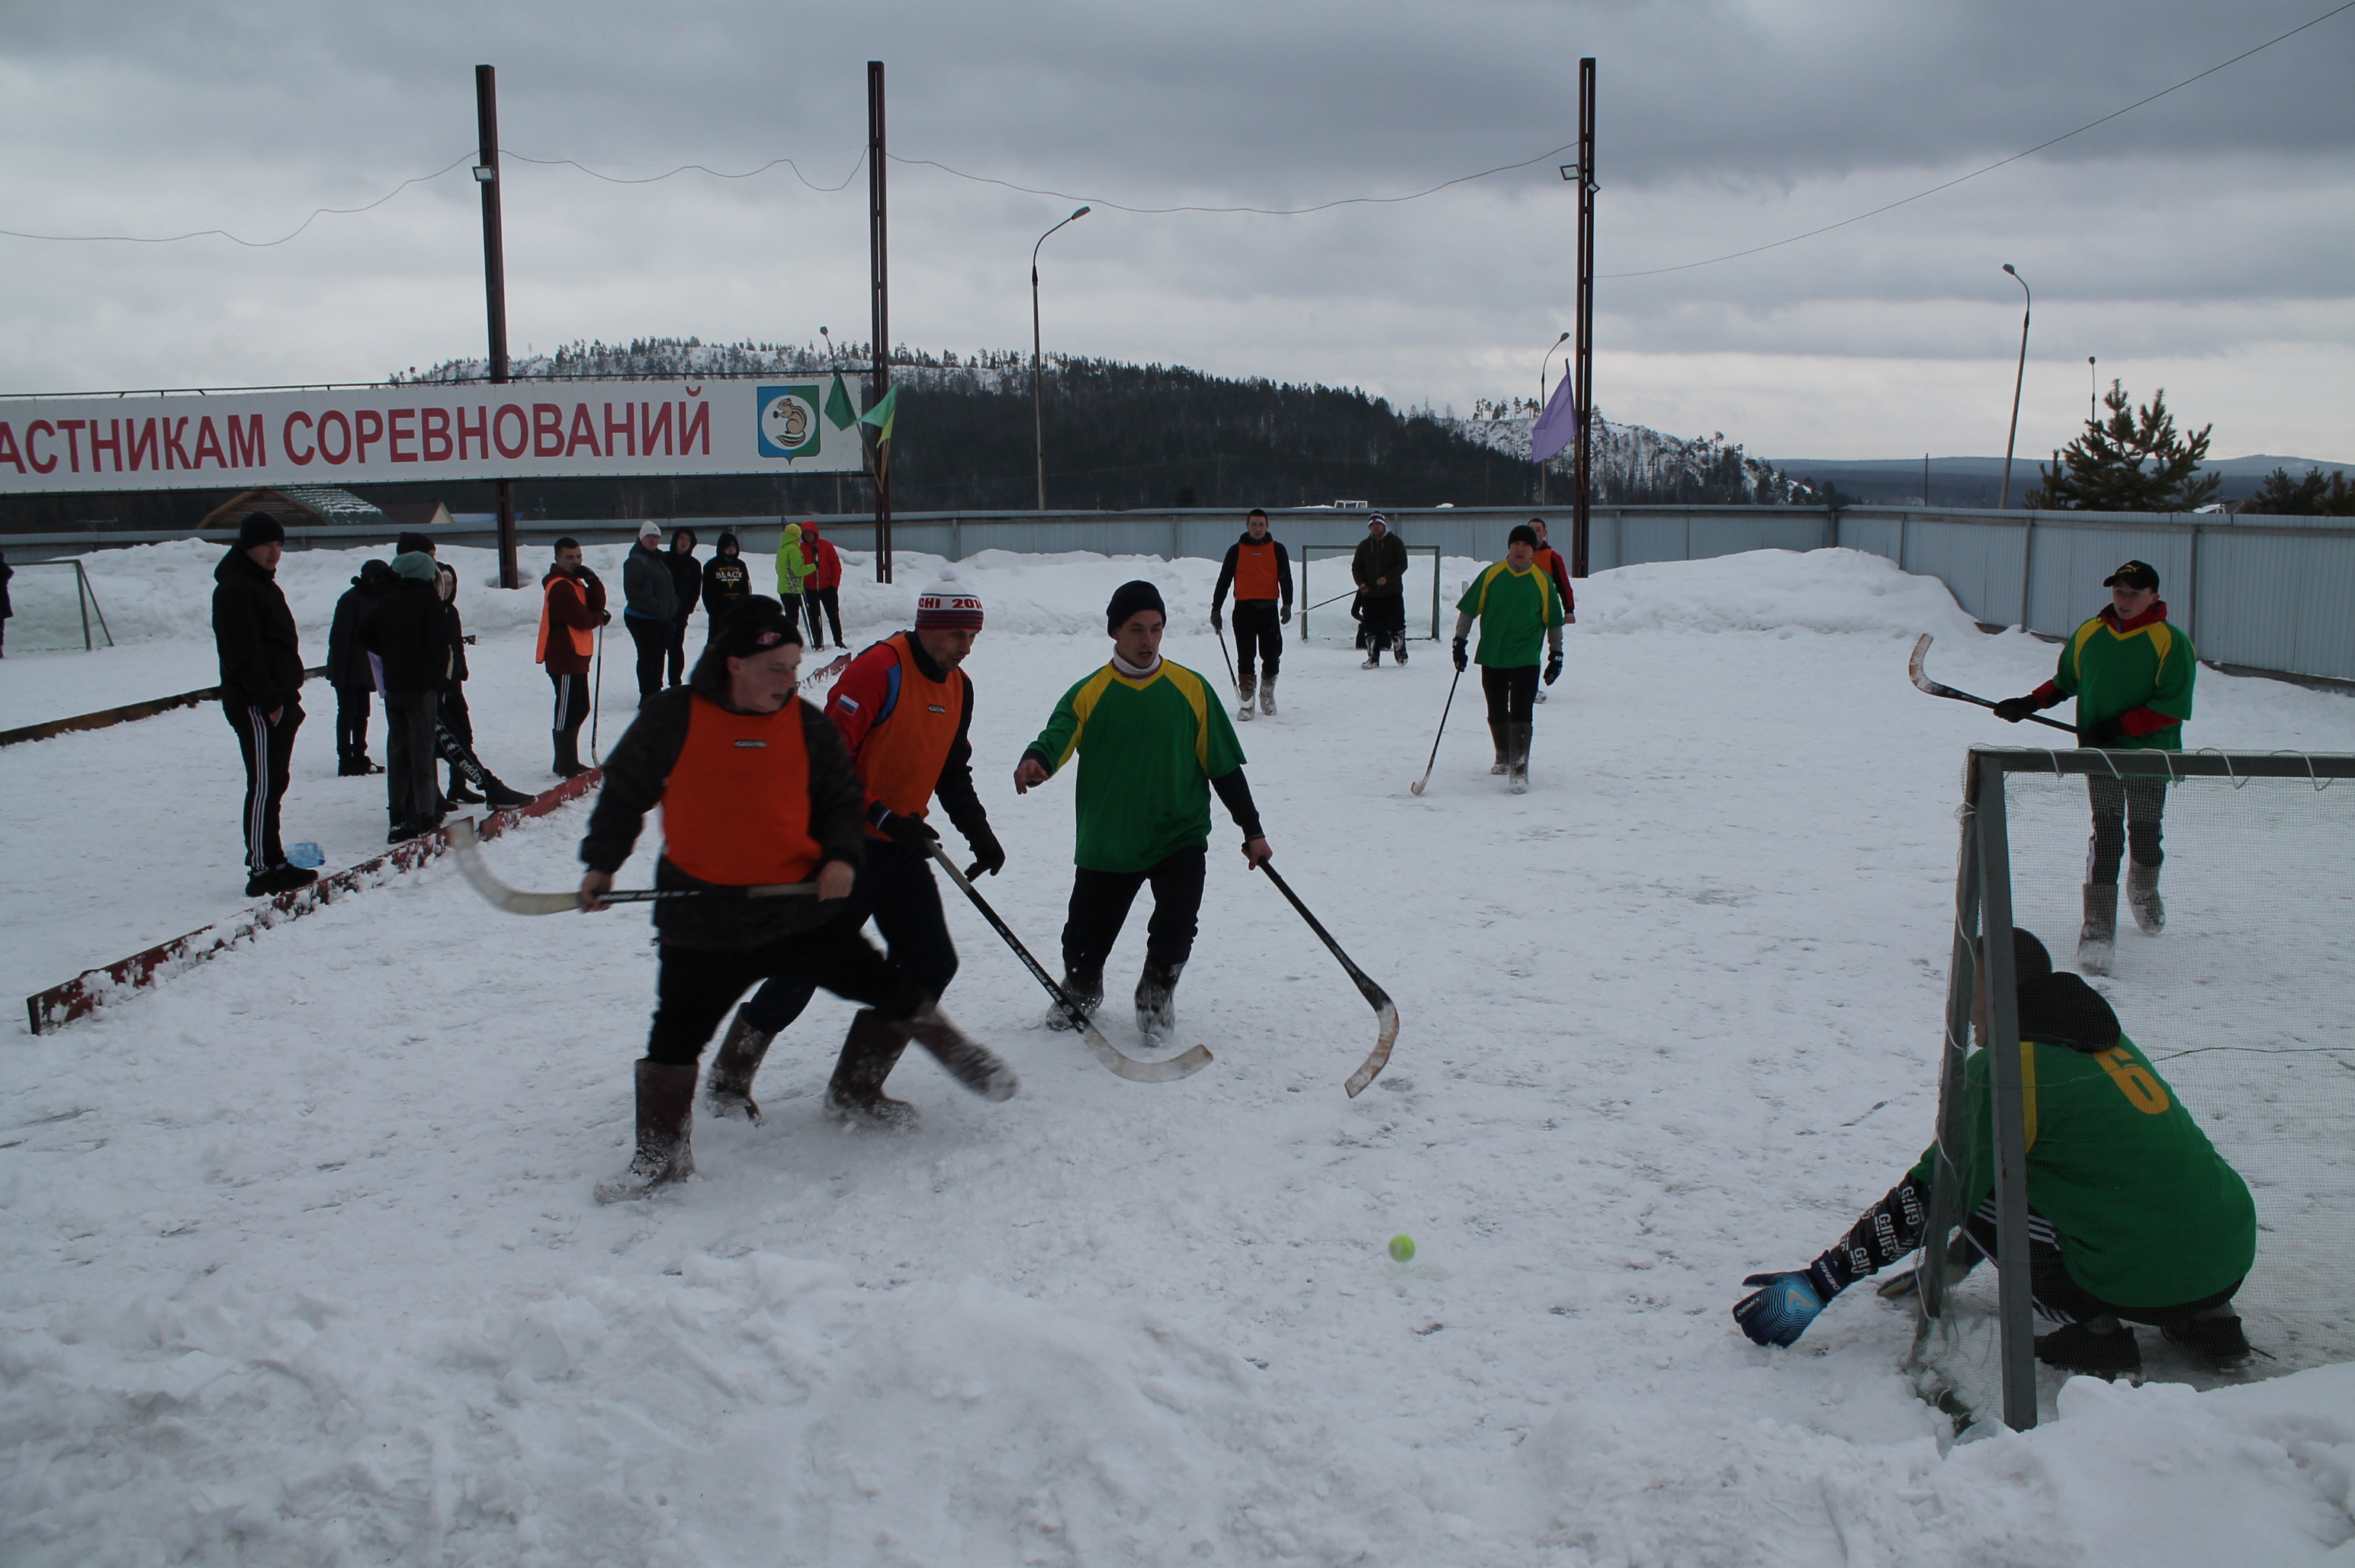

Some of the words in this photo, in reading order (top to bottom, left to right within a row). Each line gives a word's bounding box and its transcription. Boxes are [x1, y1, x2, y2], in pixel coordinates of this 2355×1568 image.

[283, 386, 711, 466] СОРЕВНОВАНИЙ
[2093, 1047, 2170, 1115] 6
[1819, 1260, 1841, 1291] DEMIX
